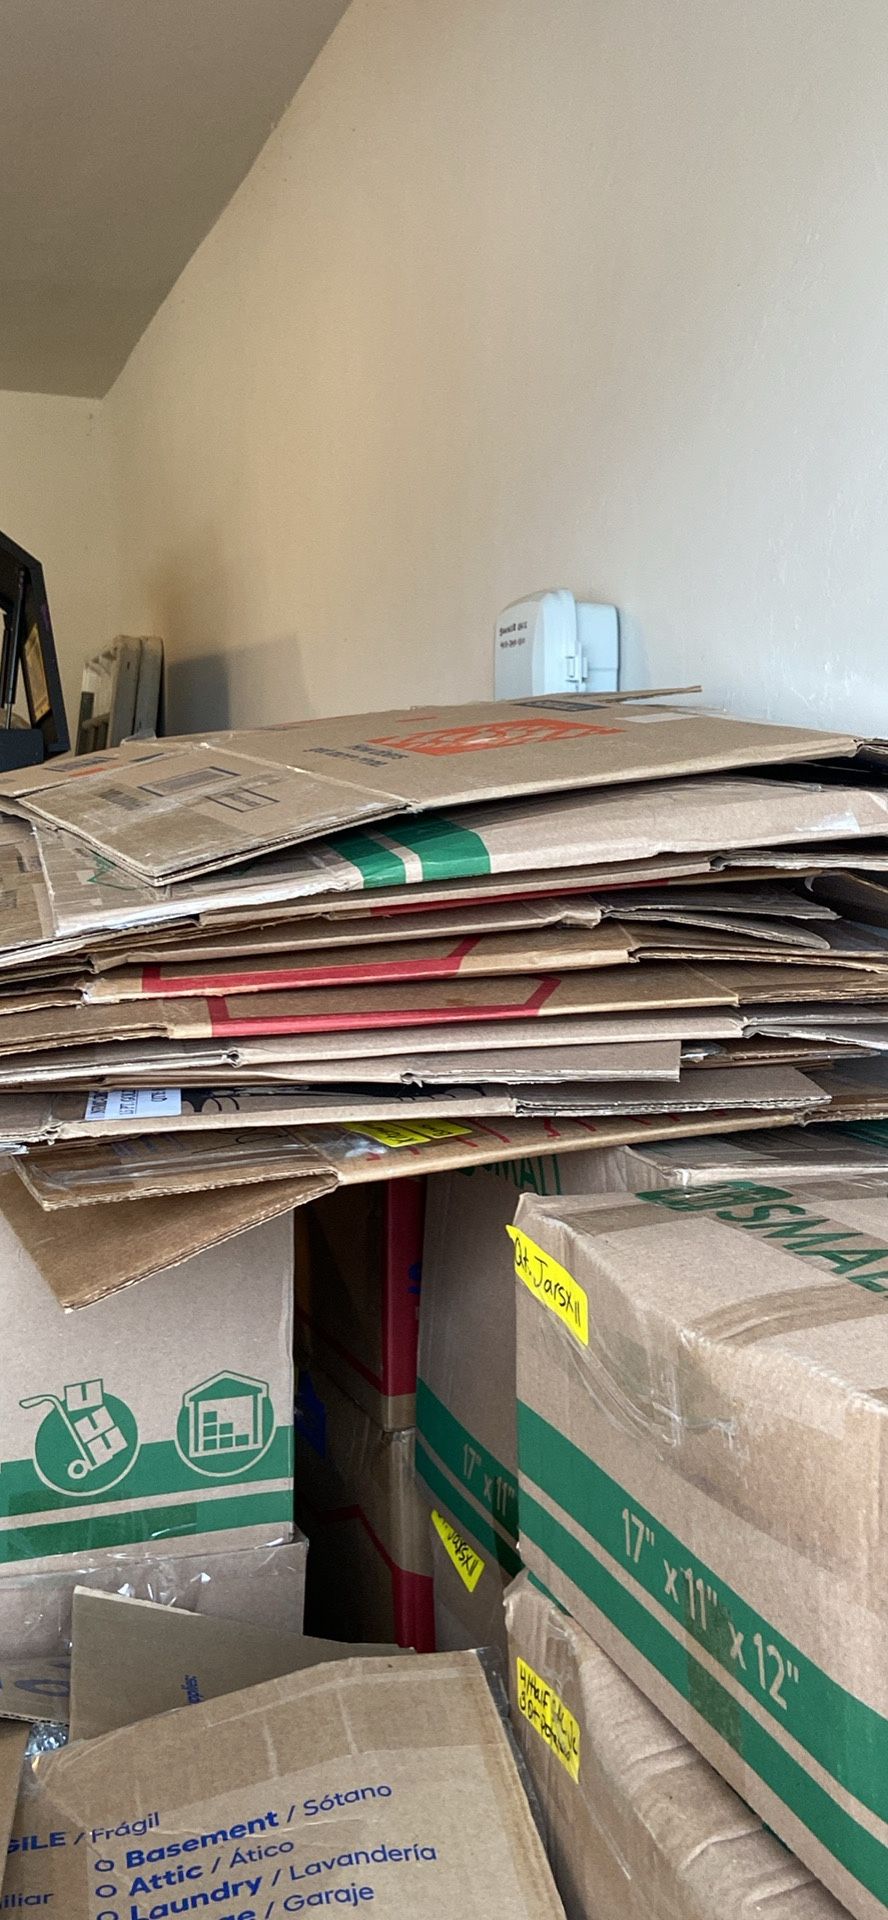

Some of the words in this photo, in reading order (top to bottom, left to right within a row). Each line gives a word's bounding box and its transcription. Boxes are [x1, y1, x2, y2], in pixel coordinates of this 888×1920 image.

[716, 1203, 888, 1299] SMAL
[622, 1508, 655, 1564] 17"
[663, 1559, 680, 1604] x
[683, 1567, 718, 1632] 11"
[727, 1621, 747, 1671] x
[752, 1633, 800, 1711] 12"
[92, 1812, 160, 1843] Frágil
[126, 1811, 279, 1869] Basement
[303, 1785, 392, 1816] Sótano
[0, 1892, 54, 1910] iliar
[129, 1865, 204, 1896] Attic
[230, 1841, 294, 1868] Ático
[130, 1875, 263, 1920] Laundry
[289, 1844, 437, 1880] Lavandería
[283, 1883, 374, 1912] Garaje
